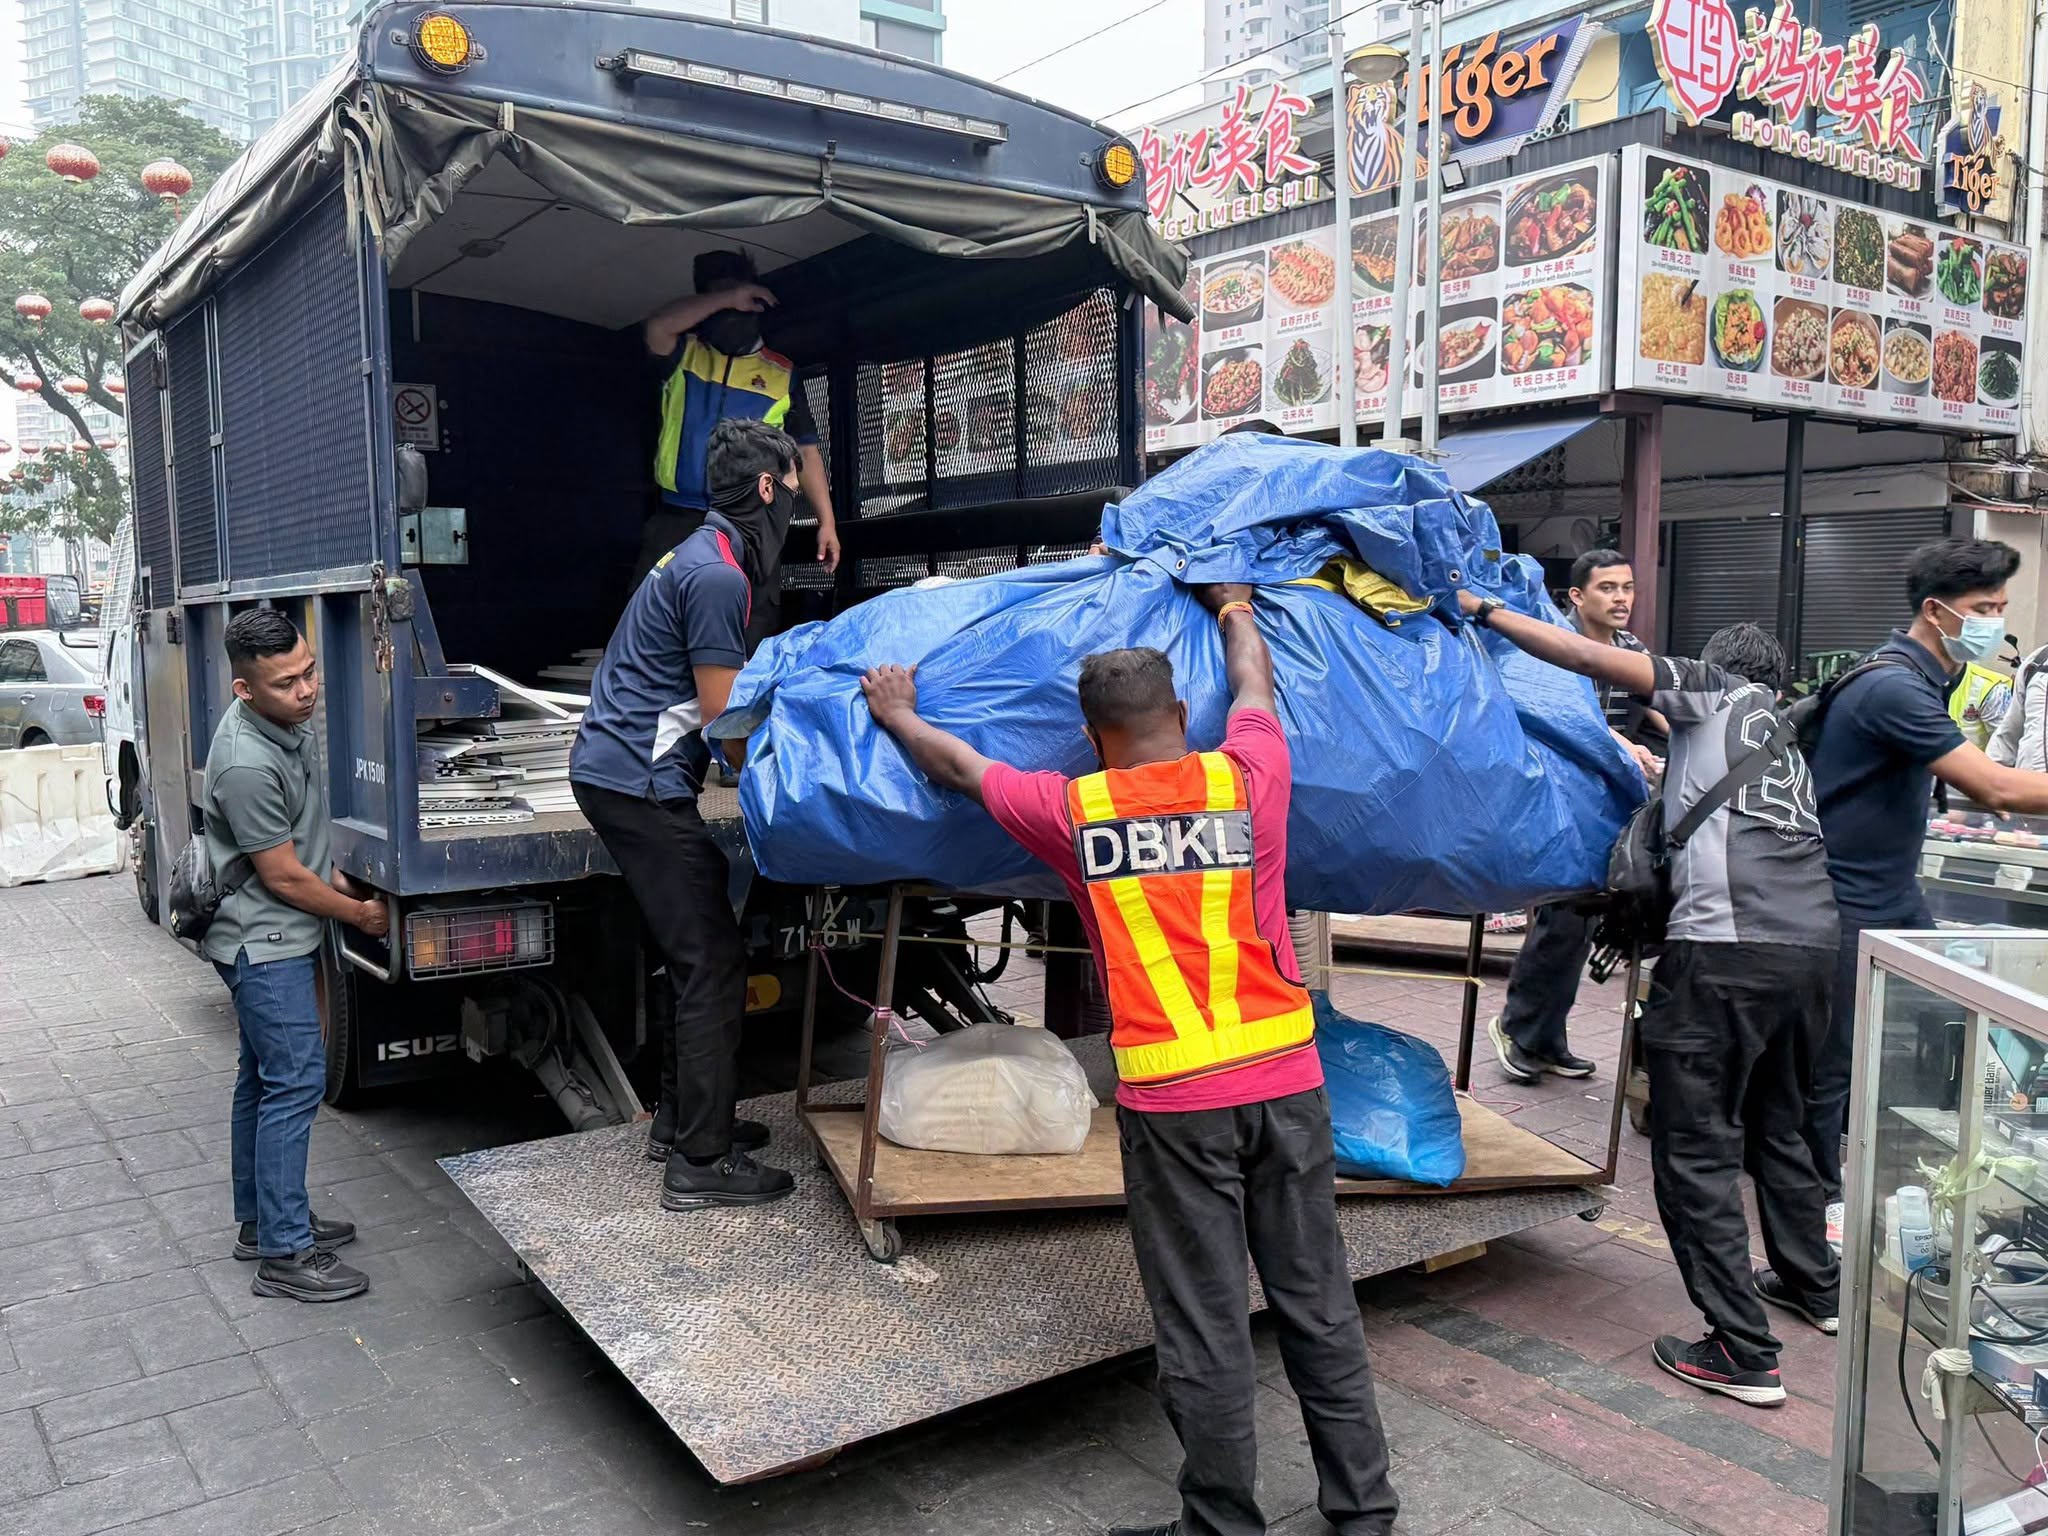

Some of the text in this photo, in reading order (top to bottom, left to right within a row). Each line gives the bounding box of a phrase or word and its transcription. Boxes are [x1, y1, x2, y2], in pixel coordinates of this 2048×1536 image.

[1743, 0, 1924, 160] 鸿记美食
[1741, 114, 1921, 191] HONGJIMEISHI
[1950, 152, 2001, 211] Tiger
[1154, 175, 1317, 238] GJIMEISHI
[1513, 368, 1577, 387] 铁板日本豆腐
[1082, 817, 1249, 876] DBKL
[780, 921, 838, 953] 716
[378, 1034, 457, 1062] ISUZ
